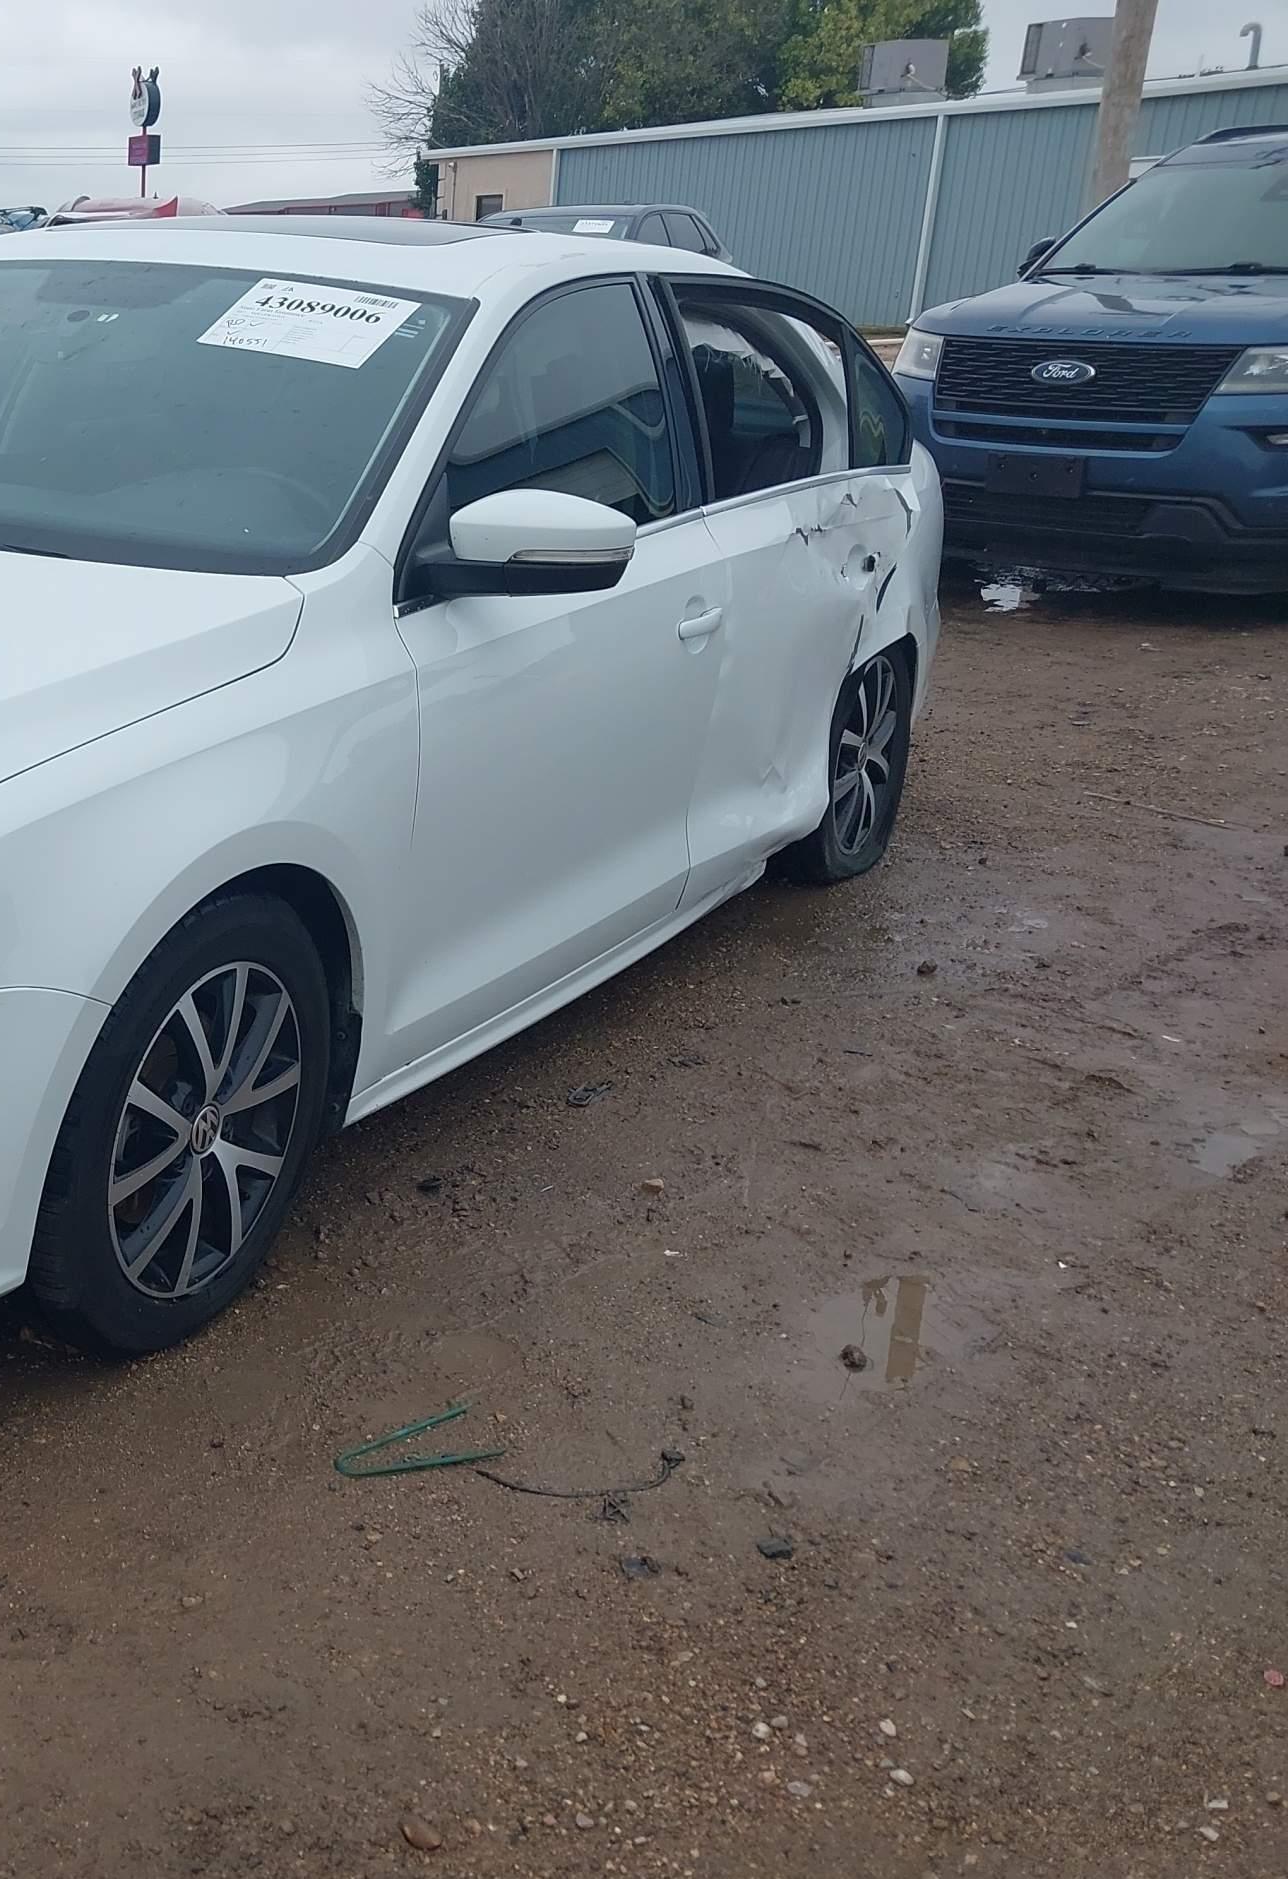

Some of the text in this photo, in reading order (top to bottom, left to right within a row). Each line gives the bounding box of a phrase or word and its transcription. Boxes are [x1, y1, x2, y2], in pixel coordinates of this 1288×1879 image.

[255, 295, 386, 325] 43089006
[985, 325, 1193, 338] EXPLORER
[1042, 363, 1080, 379] Ford
